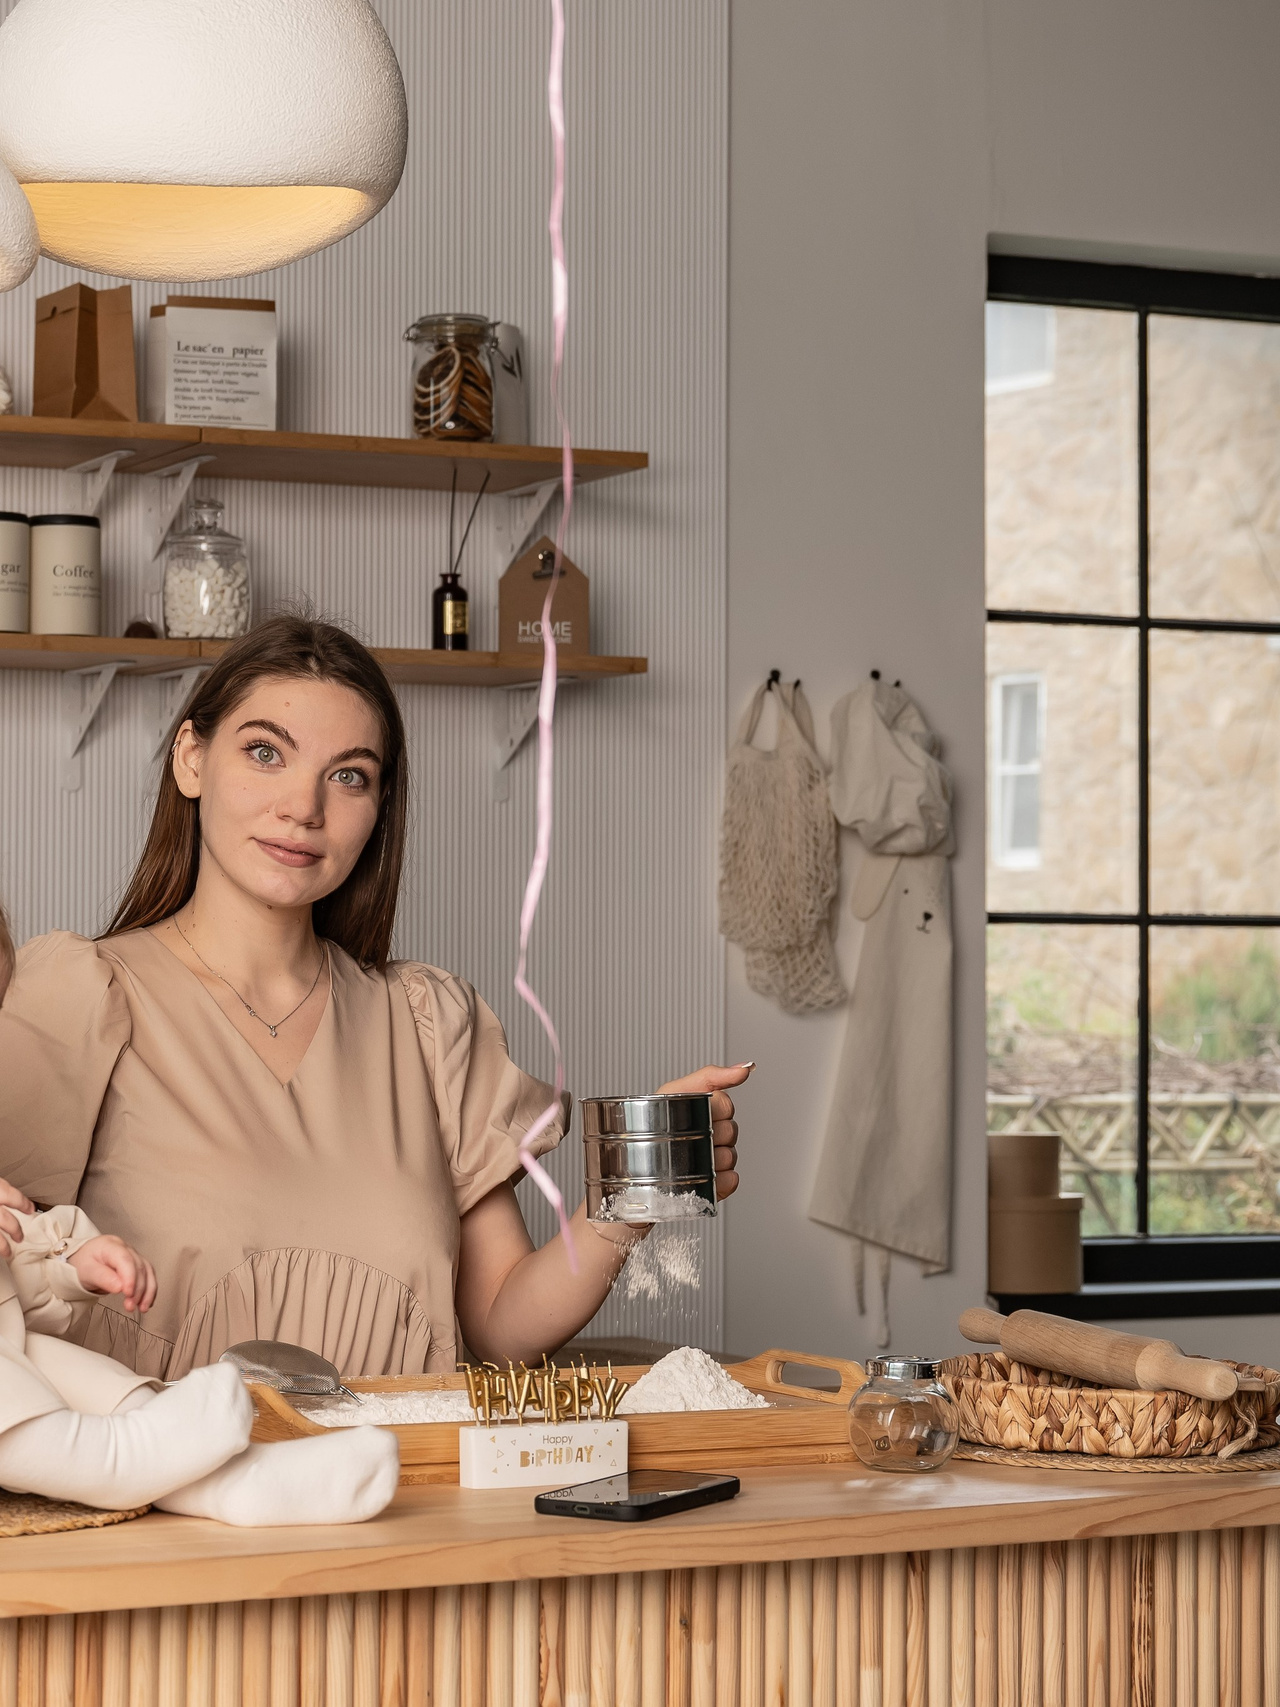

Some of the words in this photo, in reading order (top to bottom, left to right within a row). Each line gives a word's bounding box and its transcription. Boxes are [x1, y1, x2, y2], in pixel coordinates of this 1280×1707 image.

[177, 341, 190, 352] Le
[232, 345, 264, 359] papier
[53, 565, 95, 578] Coffee
[518, 621, 571, 636] HOME
[542, 1434, 574, 1446] Happy
